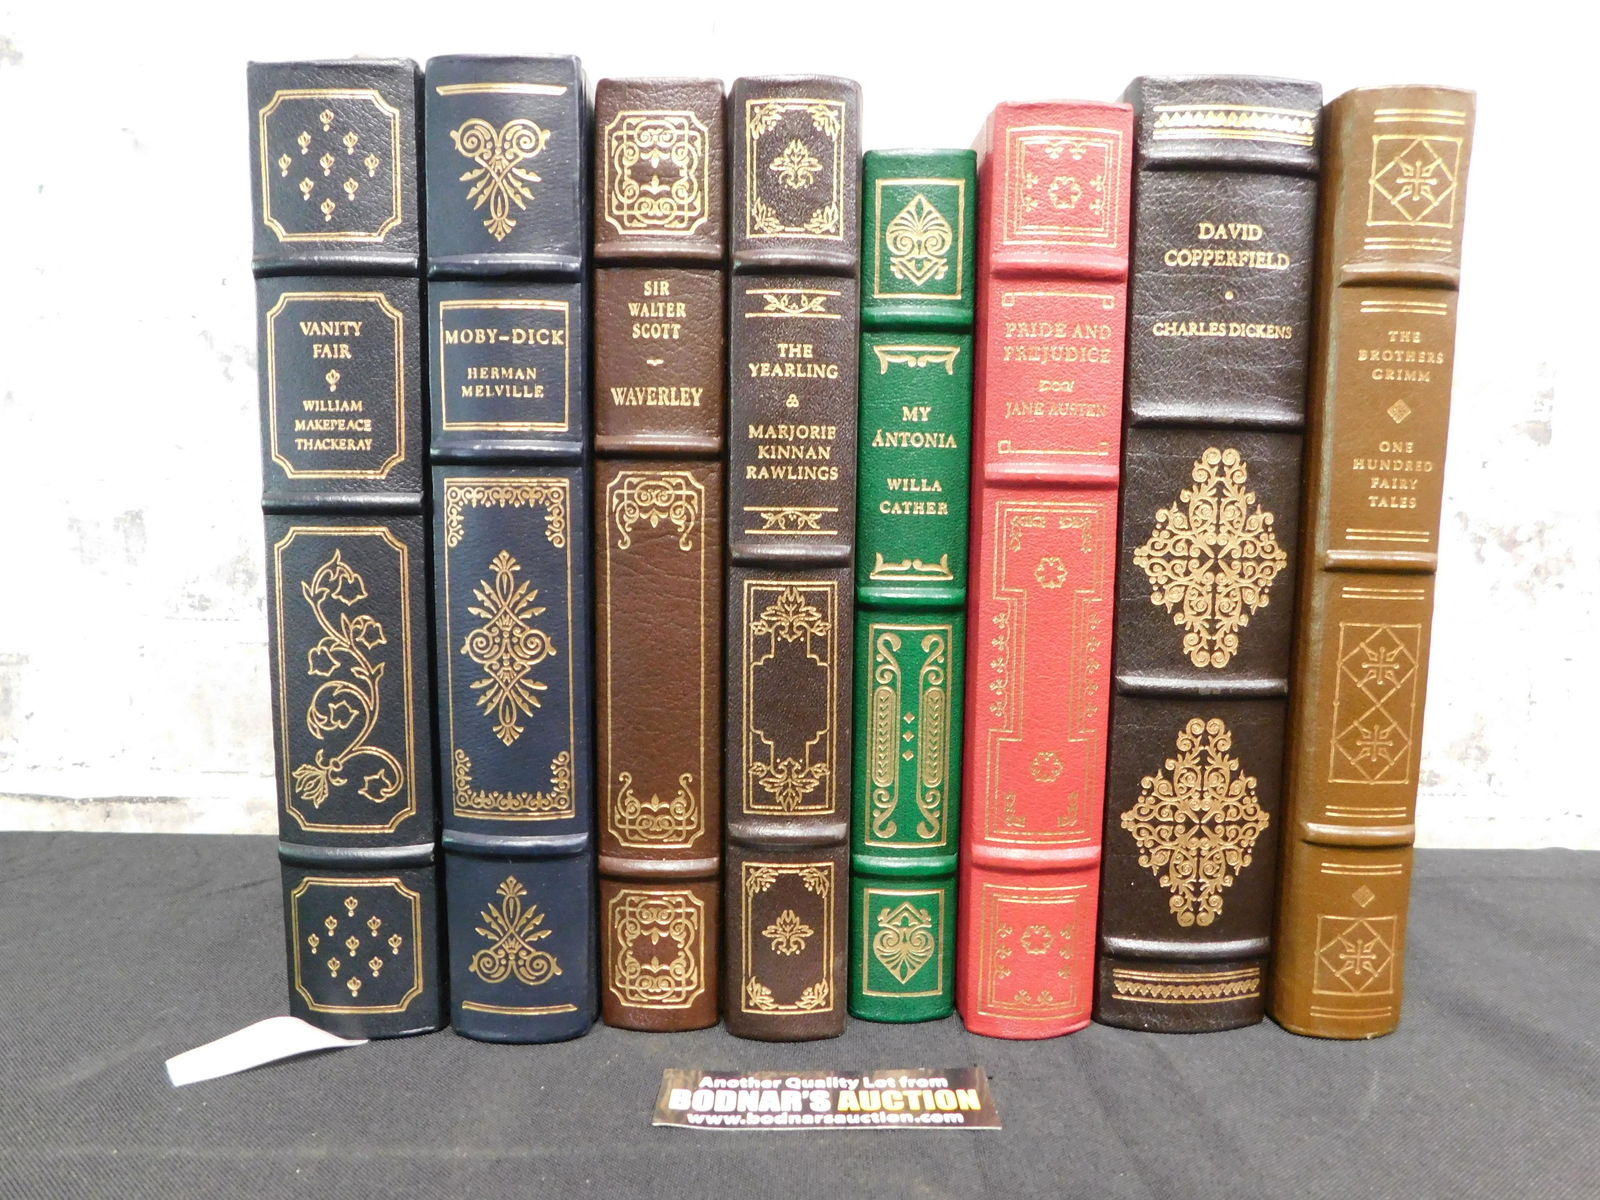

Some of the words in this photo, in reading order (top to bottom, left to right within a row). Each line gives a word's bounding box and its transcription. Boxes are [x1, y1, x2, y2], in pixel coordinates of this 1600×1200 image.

[1198, 222, 1263, 241] DAVID
[1164, 249, 1290, 270] COPPERFIELD
[643, 280, 670, 296] SIR
[628, 302, 687, 318] WALTER
[300, 321, 363, 336] VANITY
[632, 323, 681, 339] SCOTT
[1005, 322, 1067, 338] PRIDE
[1072, 323, 1112, 340] AND
[1152, 321, 1226, 337] CHARLES
[1228, 322, 1292, 340] DICKENS
[445, 328, 564, 345] MOBY-DICK
[1387, 330, 1421, 343] THE
[312, 344, 352, 359] FAIR
[777, 343, 813, 358] THE
[1003, 345, 1112, 365] PREJUDICE
[1357, 349, 1445, 364] BROTHERS
[467, 367, 537, 380] HERMAN
[748, 362, 839, 379] YEARLING
[1371, 368, 1431, 382] GRIMM
[461, 384, 545, 398] MELVILLE
[610, 387, 703, 407] WAVERLEY
[303, 400, 363, 412] WILLIAM
[902, 405, 932, 421] MY
[1005, 402, 1045, 419] JANE
[1048, 402, 1108, 417] AUSTEN
[294, 419, 372, 432] MAKEPEACE
[748, 424, 837, 441] MARJORIE
[294, 438, 373, 451] THACKERAY
[871, 428, 957, 448] ÁNTONIA
[757, 445, 831, 460] KINNAN
[1378, 441, 1414, 453] ONE
[746, 465, 839, 480] RAWLINGS
[1352, 458, 1434, 473] HUNDRED
[887, 478, 942, 492] WILLA
[1370, 477, 1418, 490] FAIRY
[879, 500, 948, 515] CATHER
[1368, 495, 1417, 509] TALES
[698, 1076, 782, 1089] Another
[784, 1076, 859, 1091] Quality
[862, 1076, 897, 1089] Lot
[898, 1075, 949, 1089] from
[668, 1088, 832, 1112] BODNAR'S
[837, 1088, 982, 1112] AUCTION
[687, 1111, 965, 1126] www.bodnarsauction.com
